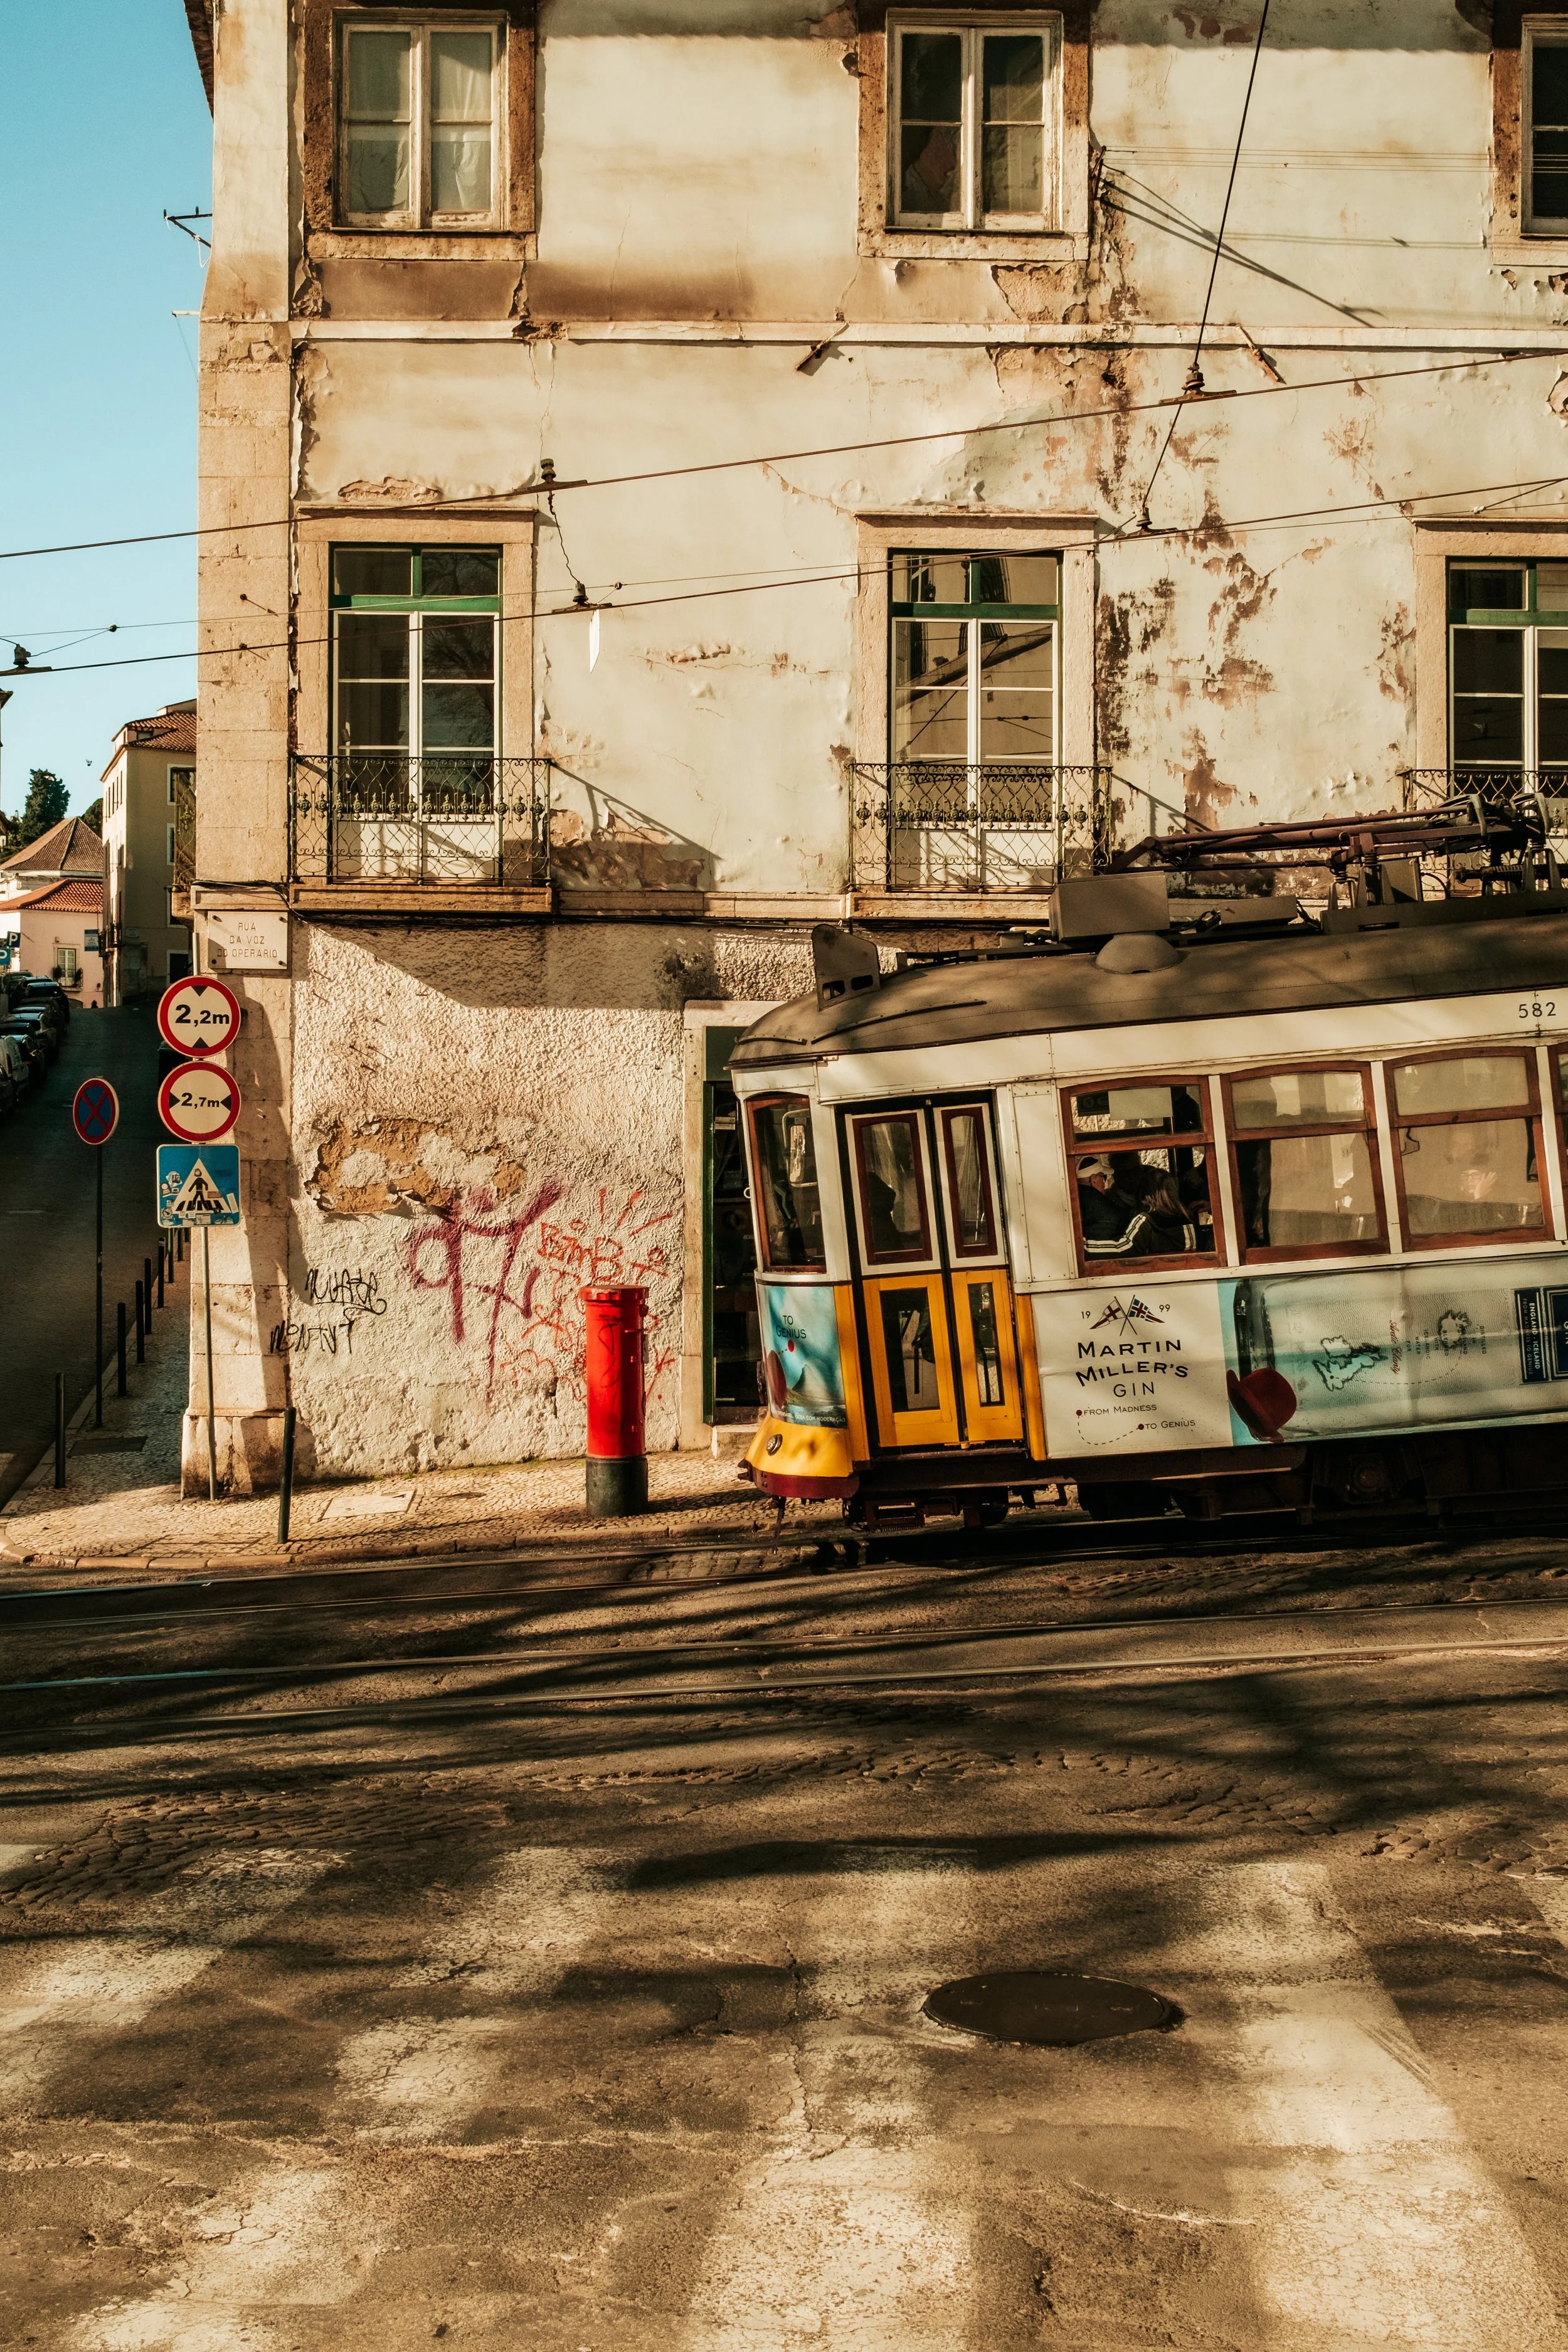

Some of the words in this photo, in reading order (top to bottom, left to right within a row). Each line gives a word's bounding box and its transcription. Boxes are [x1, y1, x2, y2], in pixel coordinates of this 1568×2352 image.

[217, 948, 228, 957] DO
[175, 1004, 230, 1027] 2,2m
[1518, 1002, 1557, 1019] 582
[181, 1092, 220, 1109] 2,7m
[1081, 1310, 1091, 1319] 19
[1159, 1304, 1170, 1313] 99
[1529, 1303, 1538, 1335] ENGLAND
[783, 1315, 793, 1325] TO
[776, 1327, 806, 1338] GENIUS
[1078, 1340, 1181, 1359] MARTIN
[1075, 1362, 1189, 1387] MILLER'S
[1113, 1382, 1155, 1397] GIN
[1114, 1404, 1157, 1413] MADNESS
[1161, 1420, 1195, 1428] GENIUS
